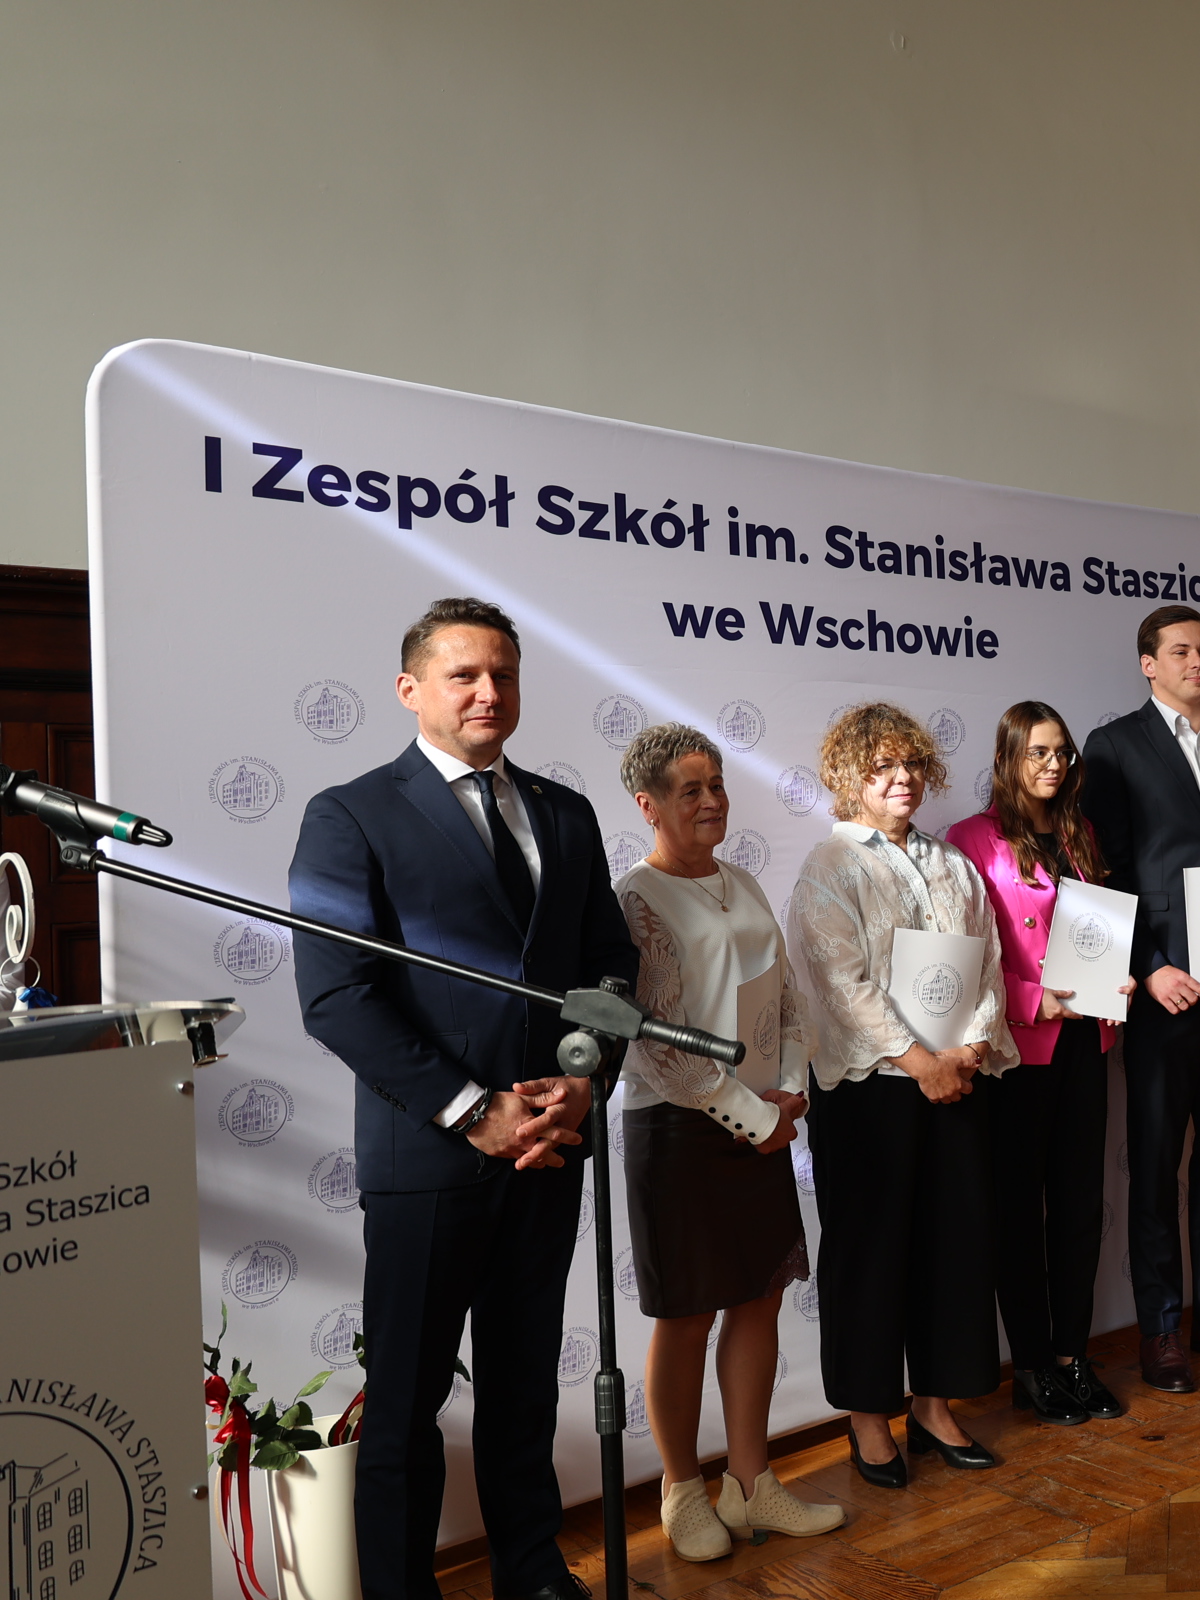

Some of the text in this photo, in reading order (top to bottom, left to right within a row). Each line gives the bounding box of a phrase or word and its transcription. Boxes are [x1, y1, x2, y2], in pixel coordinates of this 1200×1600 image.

[204, 435, 223, 494] I
[251, 442, 516, 531] Zespół
[535, 484, 710, 553] Szkół
[727, 505, 810, 565] im.
[824, 524, 1072, 593] Stanisława
[661, 600, 1000, 660] we Wschowie
[298, 684, 314, 699] SZKÓŁ
[324, 680, 360, 699] STANISŁAWA
[357, 698, 365, 726] STASZICA
[616, 694, 644, 711] STANISŁAWA
[212, 761, 230, 777] SZKÓŁ
[241, 756, 280, 776] STANISŁAWA
[276, 775, 285, 803] STASZICA
[552, 762, 582, 779] STANISŁAWA
[217, 924, 235, 941] SZKÓŁ
[280, 934, 289, 962] STASZICA
[222, 1087, 240, 1104] SZKÓŁ
[251, 1079, 289, 1095] STANISŁAWA
[285, 1094, 294, 1122] STASZICA
[0, 1149, 78, 1192] Szkół
[311, 1155, 328, 1173] SZKÓŁ
[25, 1184, 151, 1228] Staszica
[0, 1236, 79, 1275] owie
[226, 1249, 243, 1268] SZKÓŁ
[254, 1240, 293, 1255] STANISŁAWA
[289, 1253, 298, 1281] STASZICA
[5, 1377, 168, 1575] NISŁAWA STASZICA
